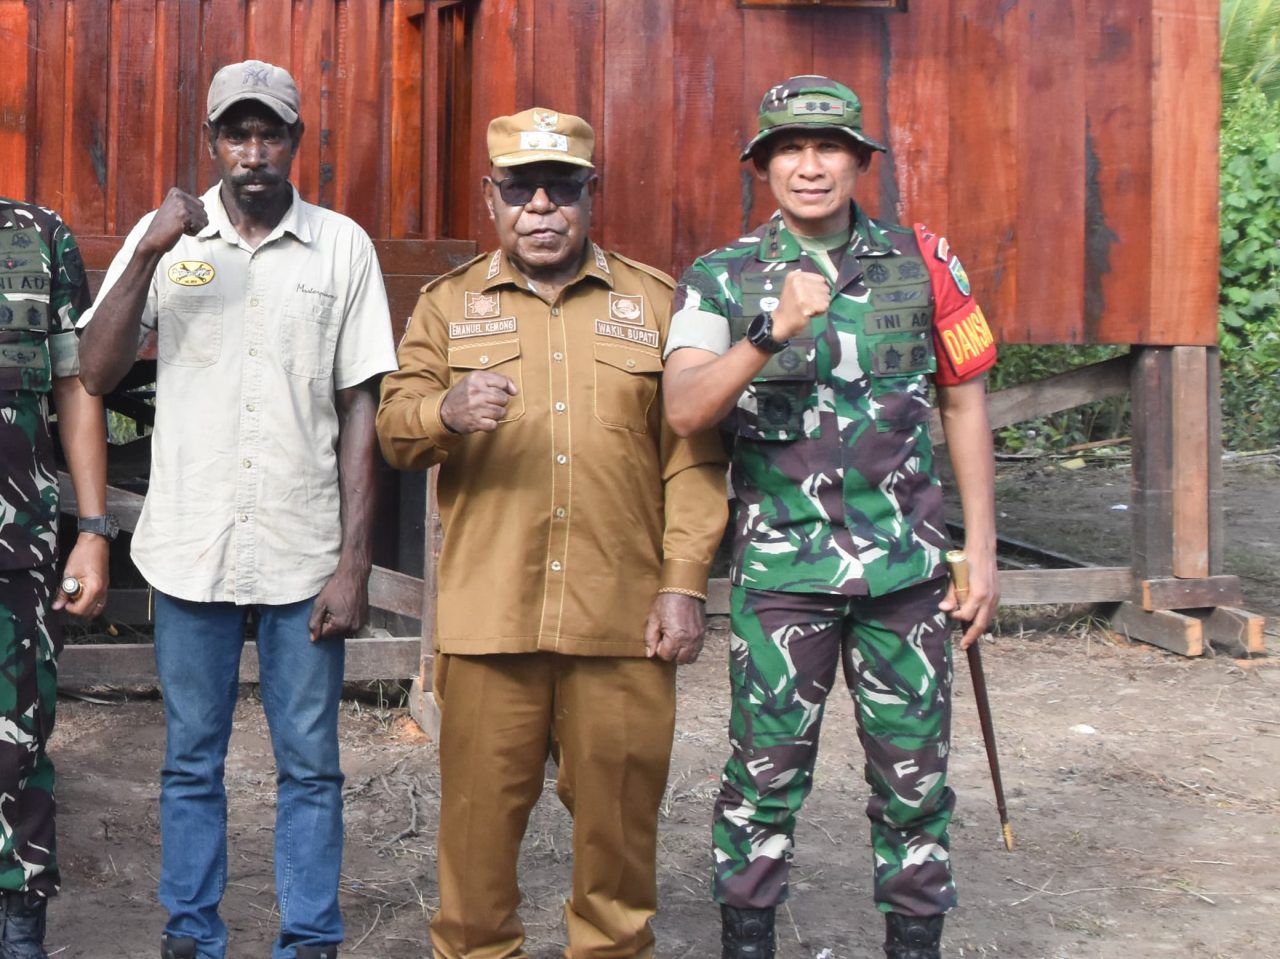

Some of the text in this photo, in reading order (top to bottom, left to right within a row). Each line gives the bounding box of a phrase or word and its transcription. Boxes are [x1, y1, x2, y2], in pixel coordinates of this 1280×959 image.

[21, 276, 45, 290] AD
[452, 320, 514, 336] EMANUEL KEMONG
[875, 312, 928, 329] TNI AD
[598, 322, 656, 345] WAKIL BUPATI
